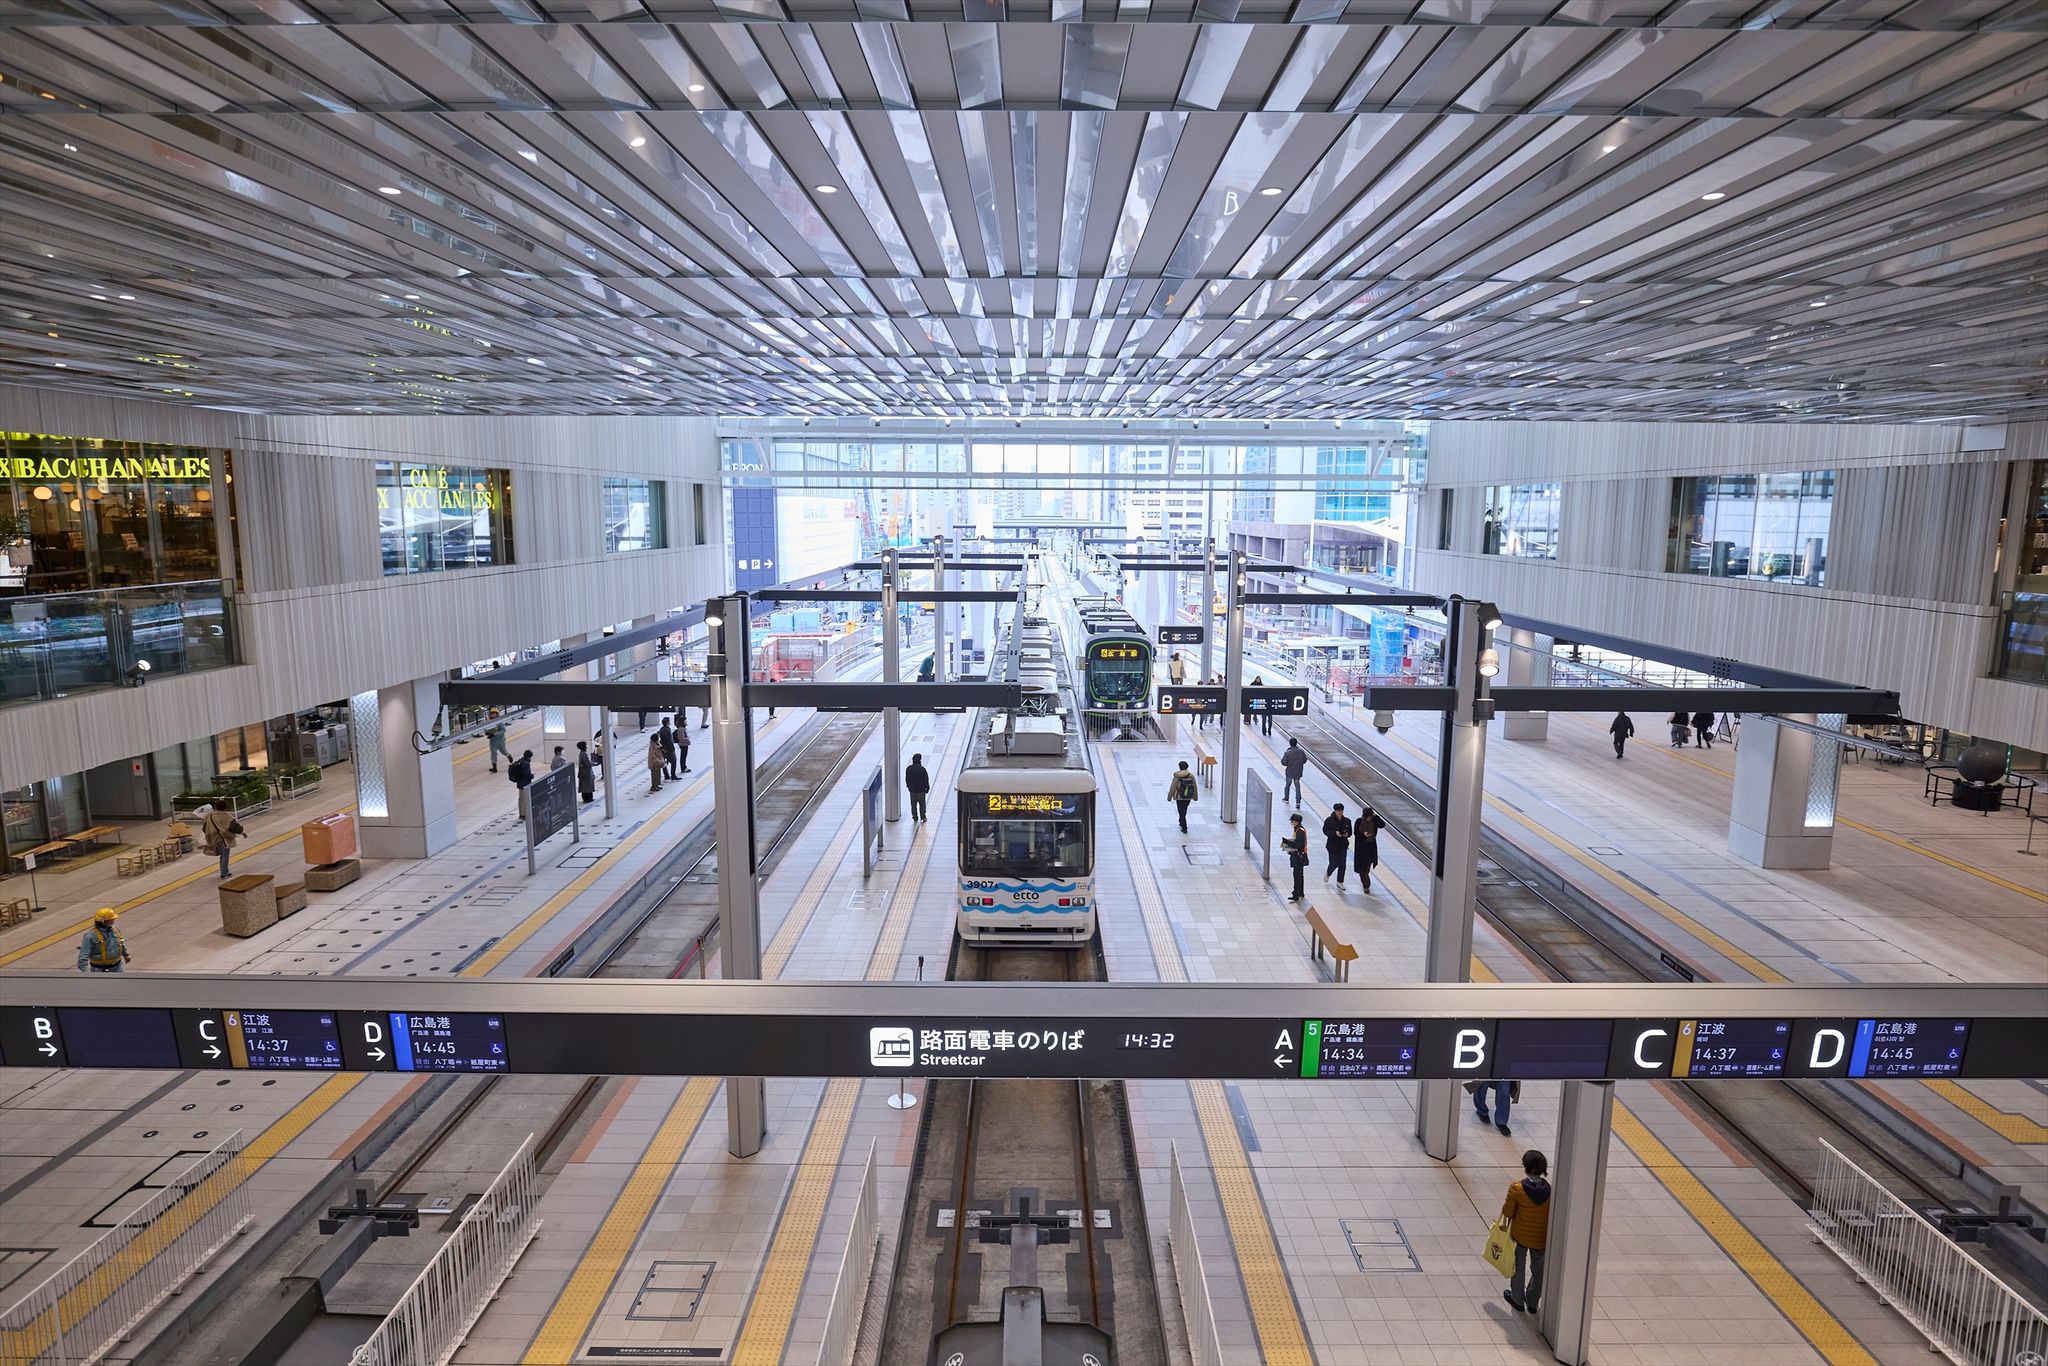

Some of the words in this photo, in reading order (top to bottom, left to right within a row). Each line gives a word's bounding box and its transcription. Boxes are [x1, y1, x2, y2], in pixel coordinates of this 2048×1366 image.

[410, 466, 448, 489] CAÉ
[1160, 631, 1168, 642] C
[1161, 694, 1173, 710] B
[1293, 695, 1305, 711] D
[1013, 891, 1039, 900] etto
[228, 1013, 237, 1026] 6
[243, 1013, 271, 1026] 江波
[395, 1016, 402, 1028] 1
[410, 1016, 451, 1029] 広島港
[33, 1017, 53, 1039] B
[199, 1019, 218, 1041] C
[364, 1021, 383, 1043] D
[1308, 1024, 1318, 1036] 5
[1323, 1023, 1365, 1036] 広島港
[1682, 1023, 1692, 1036] 6
[1697, 1022, 1726, 1035] 江波
[1862, 1023, 1869, 1035] 1
[1876, 1022, 1918, 1035] 広島港
[248, 1039, 289, 1052] 14:37
[919, 1029, 1086, 1051] 路面電車のりば
[1125, 1033, 1175, 1048] 14:32
[1274, 1029, 1294, 1050] A
[414, 1041, 456, 1054] 14:45
[1323, 1048, 1365, 1060] 14:34
[1453, 1029, 1486, 1069] B
[1633, 1029, 1668, 1069] C
[1695, 1048, 1737, 1060] 14:37
[1809, 1028, 1846, 1068] D
[1872, 1047, 1914, 1060] 14:45
[920, 1053, 986, 1066] Streetcar
